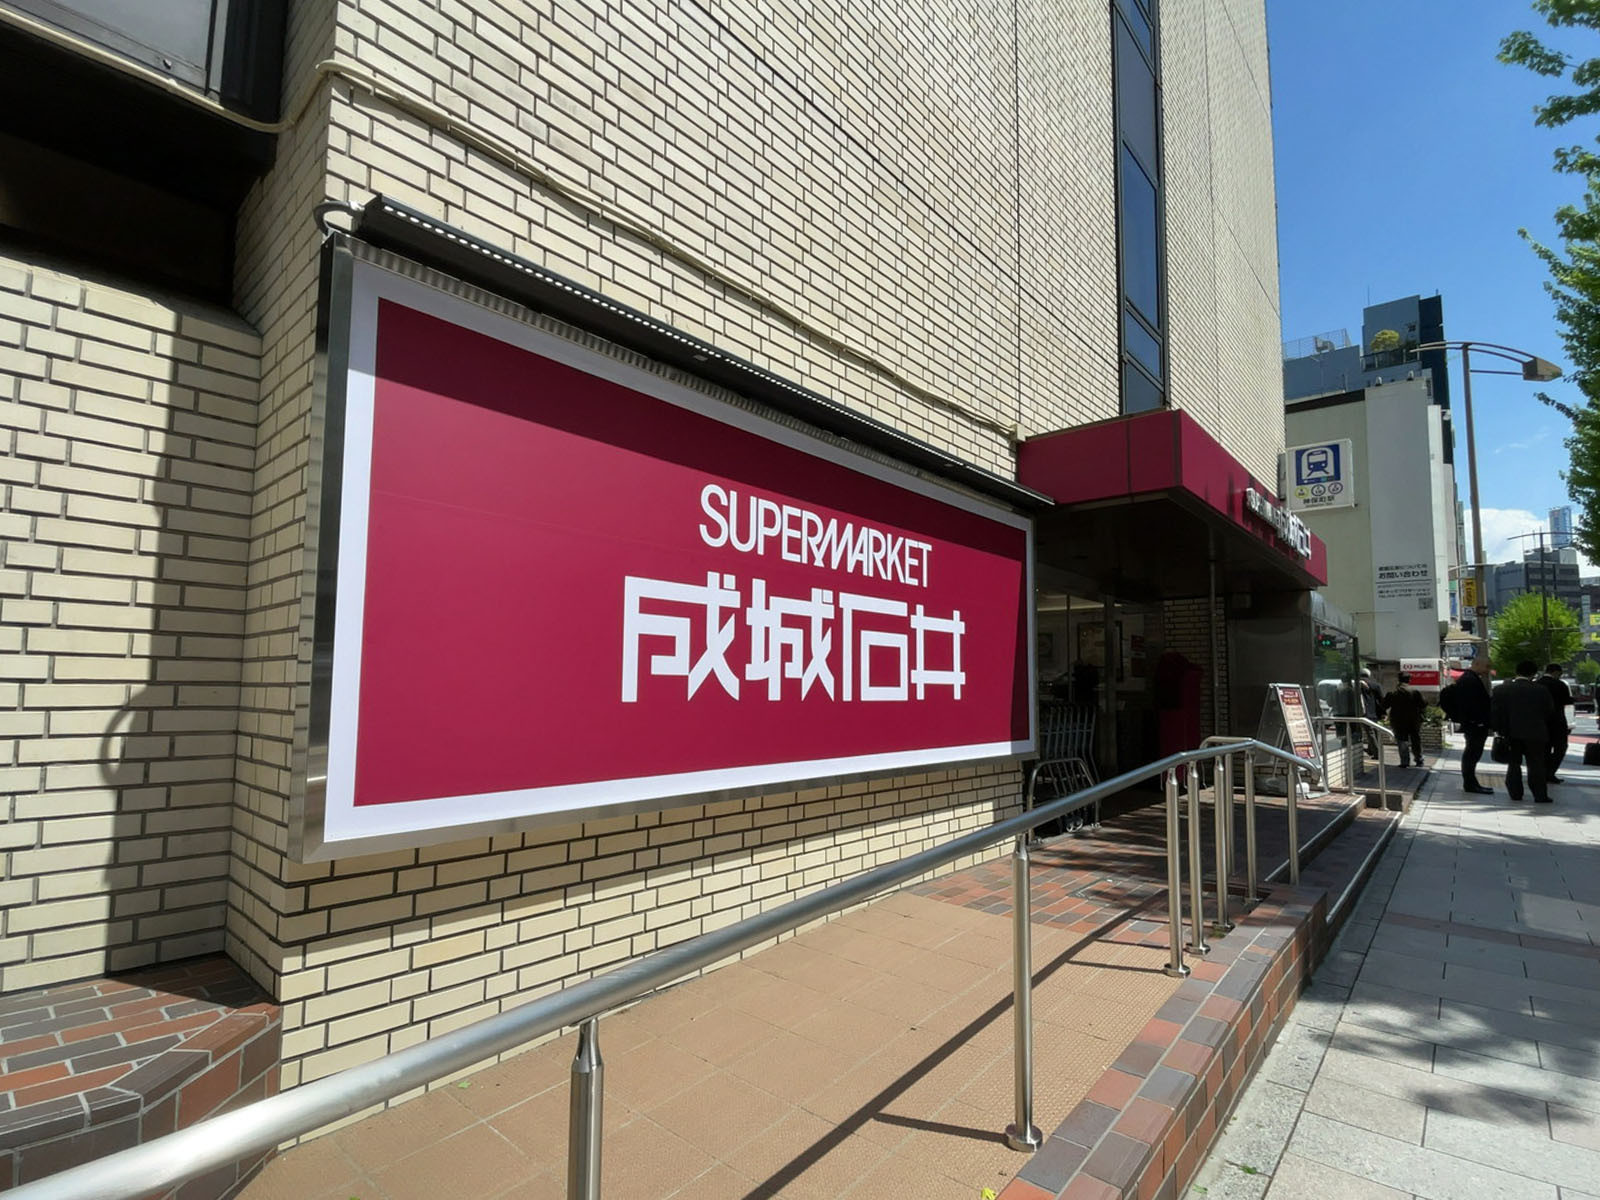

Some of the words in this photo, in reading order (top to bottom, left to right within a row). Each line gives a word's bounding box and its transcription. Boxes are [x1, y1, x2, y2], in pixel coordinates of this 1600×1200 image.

[699, 484, 932, 588] SUPERMARKET
[1378, 570, 1428, 579] お問い合わせ
[621, 571, 966, 702] 成城石井
